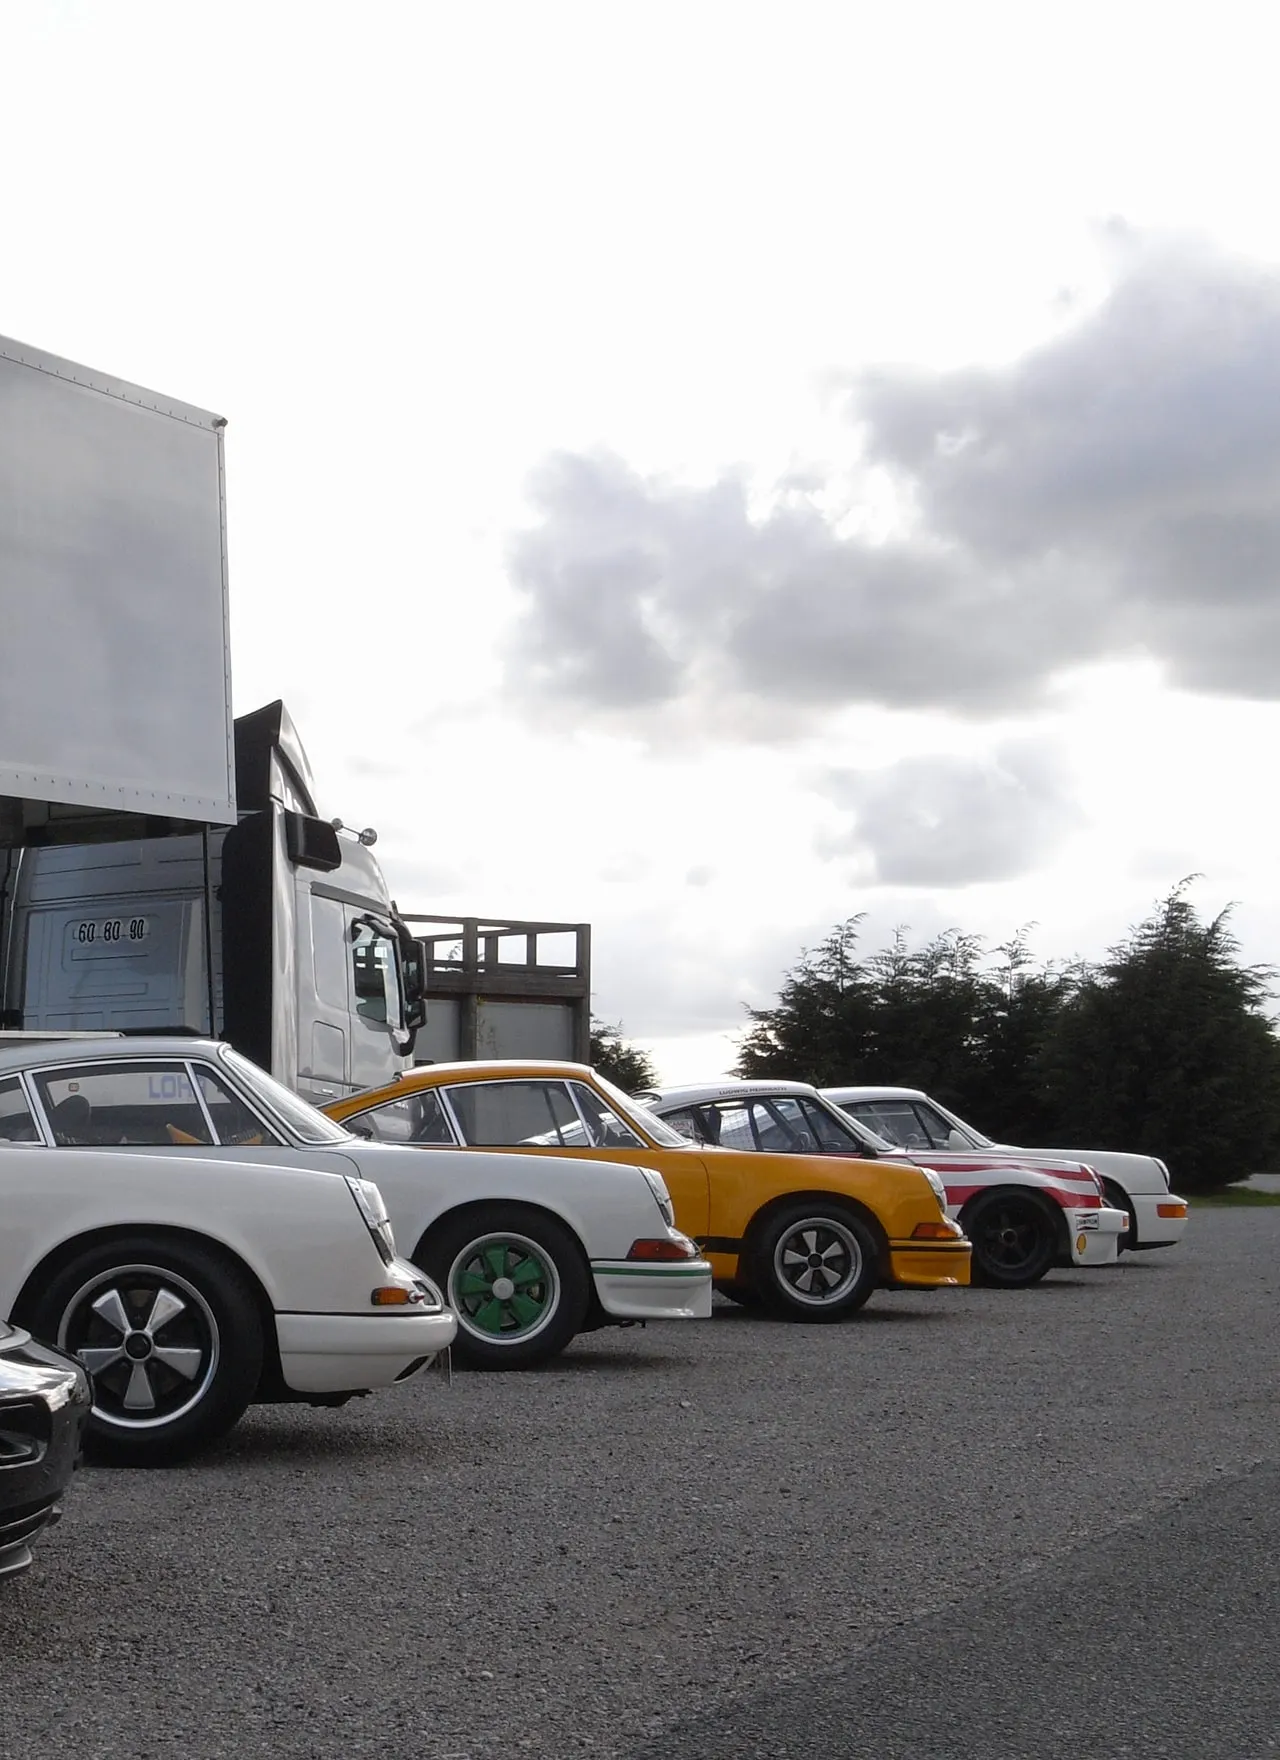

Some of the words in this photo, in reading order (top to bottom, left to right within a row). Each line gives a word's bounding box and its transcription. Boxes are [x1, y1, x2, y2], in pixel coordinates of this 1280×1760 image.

[79, 923, 96, 943] 60
[104, 921, 121, 941] 80
[129, 919, 145, 939] 90
